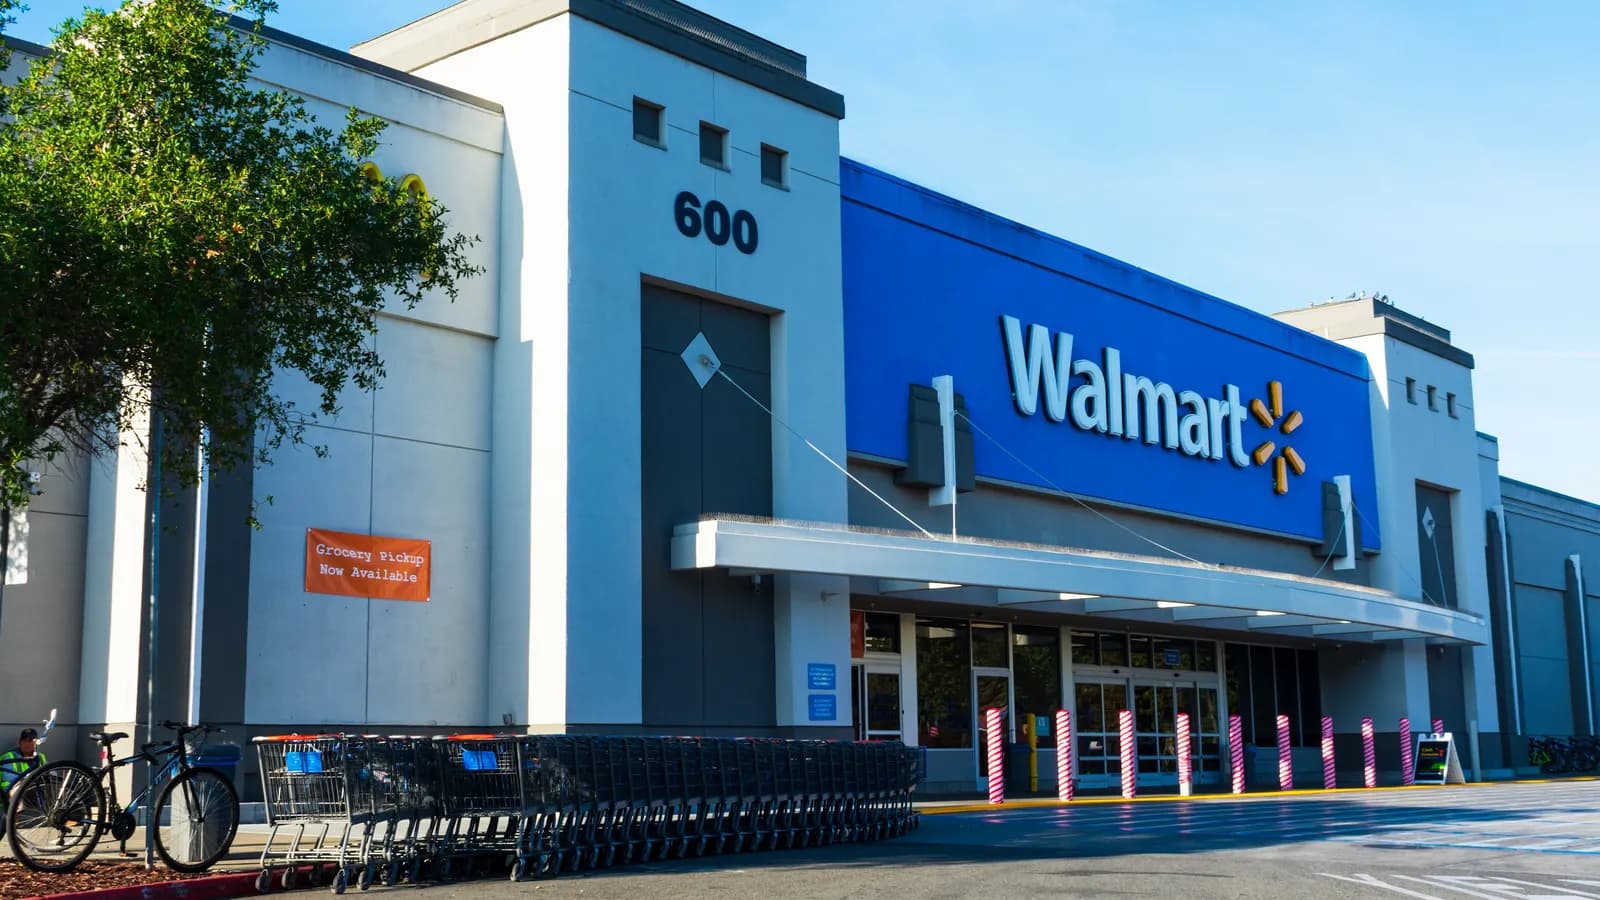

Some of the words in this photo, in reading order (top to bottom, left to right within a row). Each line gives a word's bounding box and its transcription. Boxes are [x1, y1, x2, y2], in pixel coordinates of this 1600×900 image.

[674, 190, 759, 255] 600
[1001, 314, 1250, 468] Walmart
[316, 543, 372, 562] Grocery
[379, 551, 424, 567] Pickup
[319, 564, 344, 576] Now
[352, 567, 417, 582] Available
